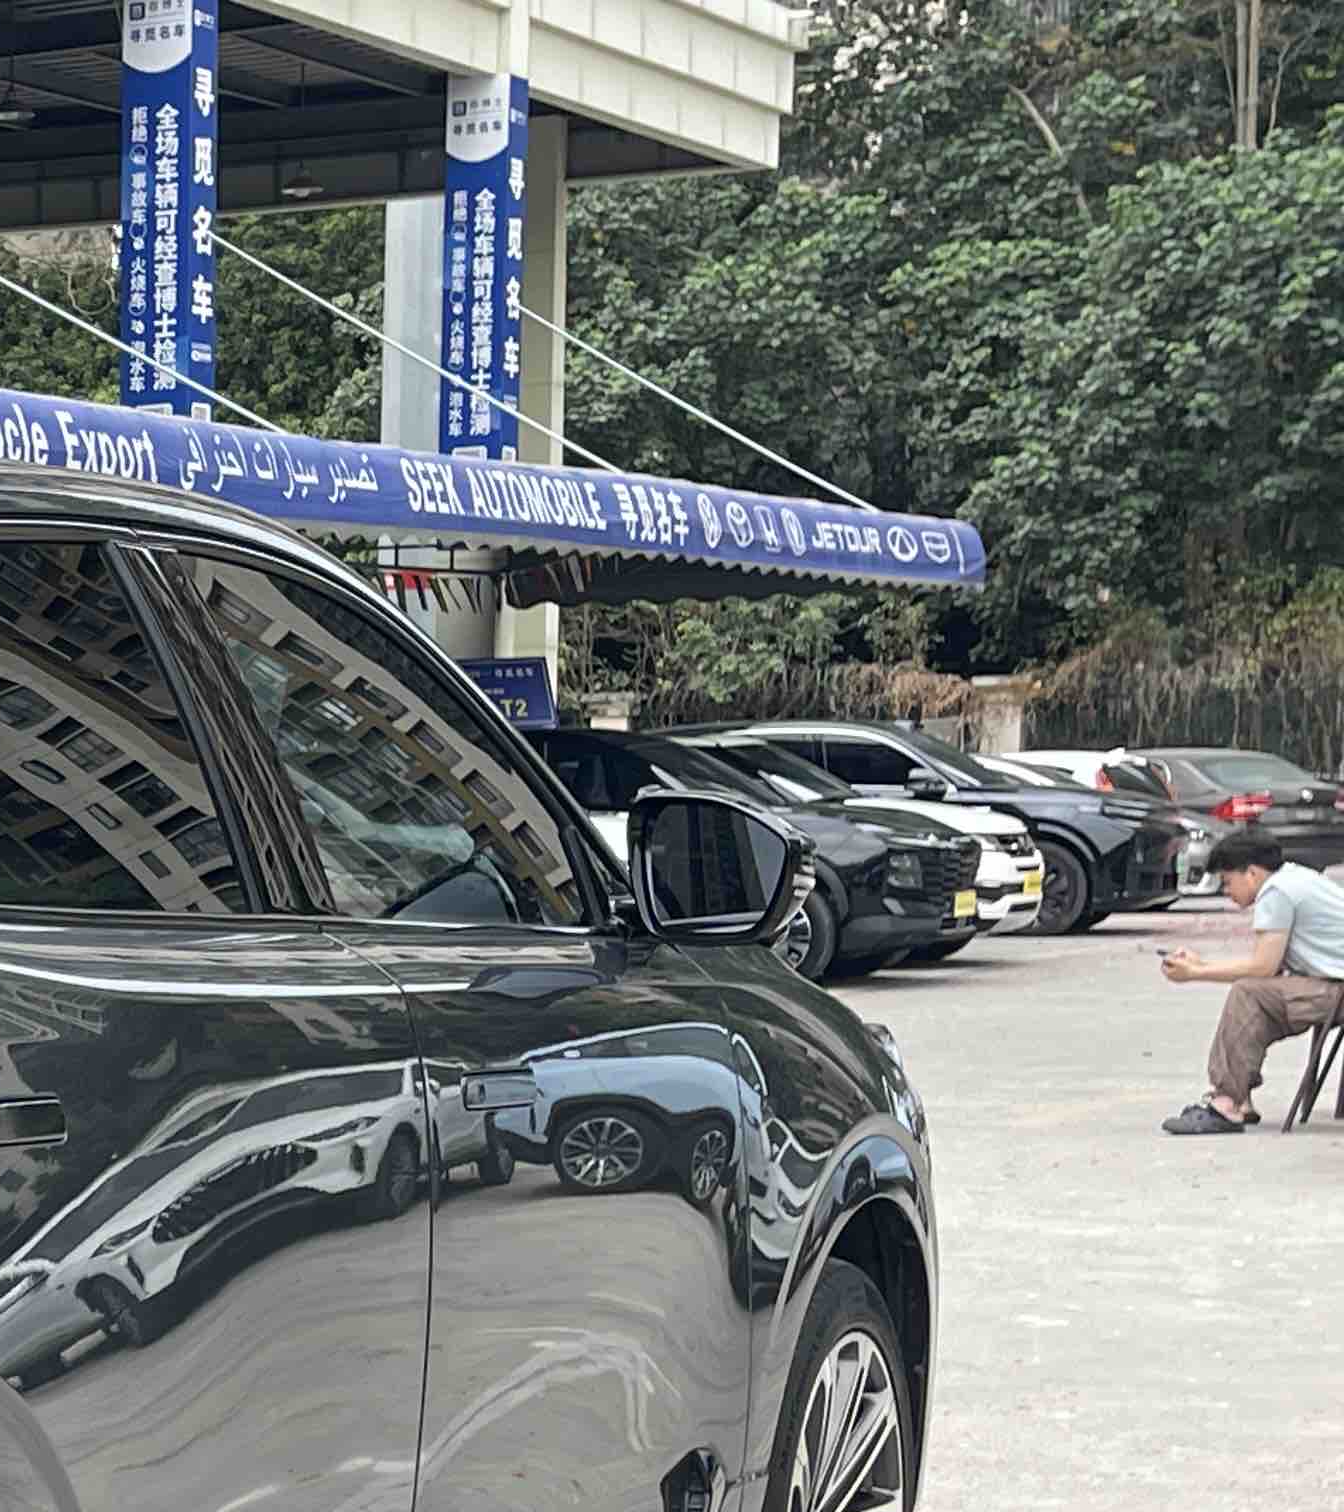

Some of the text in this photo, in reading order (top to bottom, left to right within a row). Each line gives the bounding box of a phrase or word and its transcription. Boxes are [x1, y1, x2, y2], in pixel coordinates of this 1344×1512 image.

[192, 66, 215, 324] 寻觅名车
[153, 102, 180, 391] 全场车辆可经查博士检测
[503, 157, 525, 379] 寻觅名车
[55, 410, 159, 483] Export
[400, 457, 608, 531] SEEK AUTOMOBILE
[614, 483, 690, 547] 寻觅名车
[812, 521, 883, 555] JETOUR
[499, 698, 529, 717] T2
